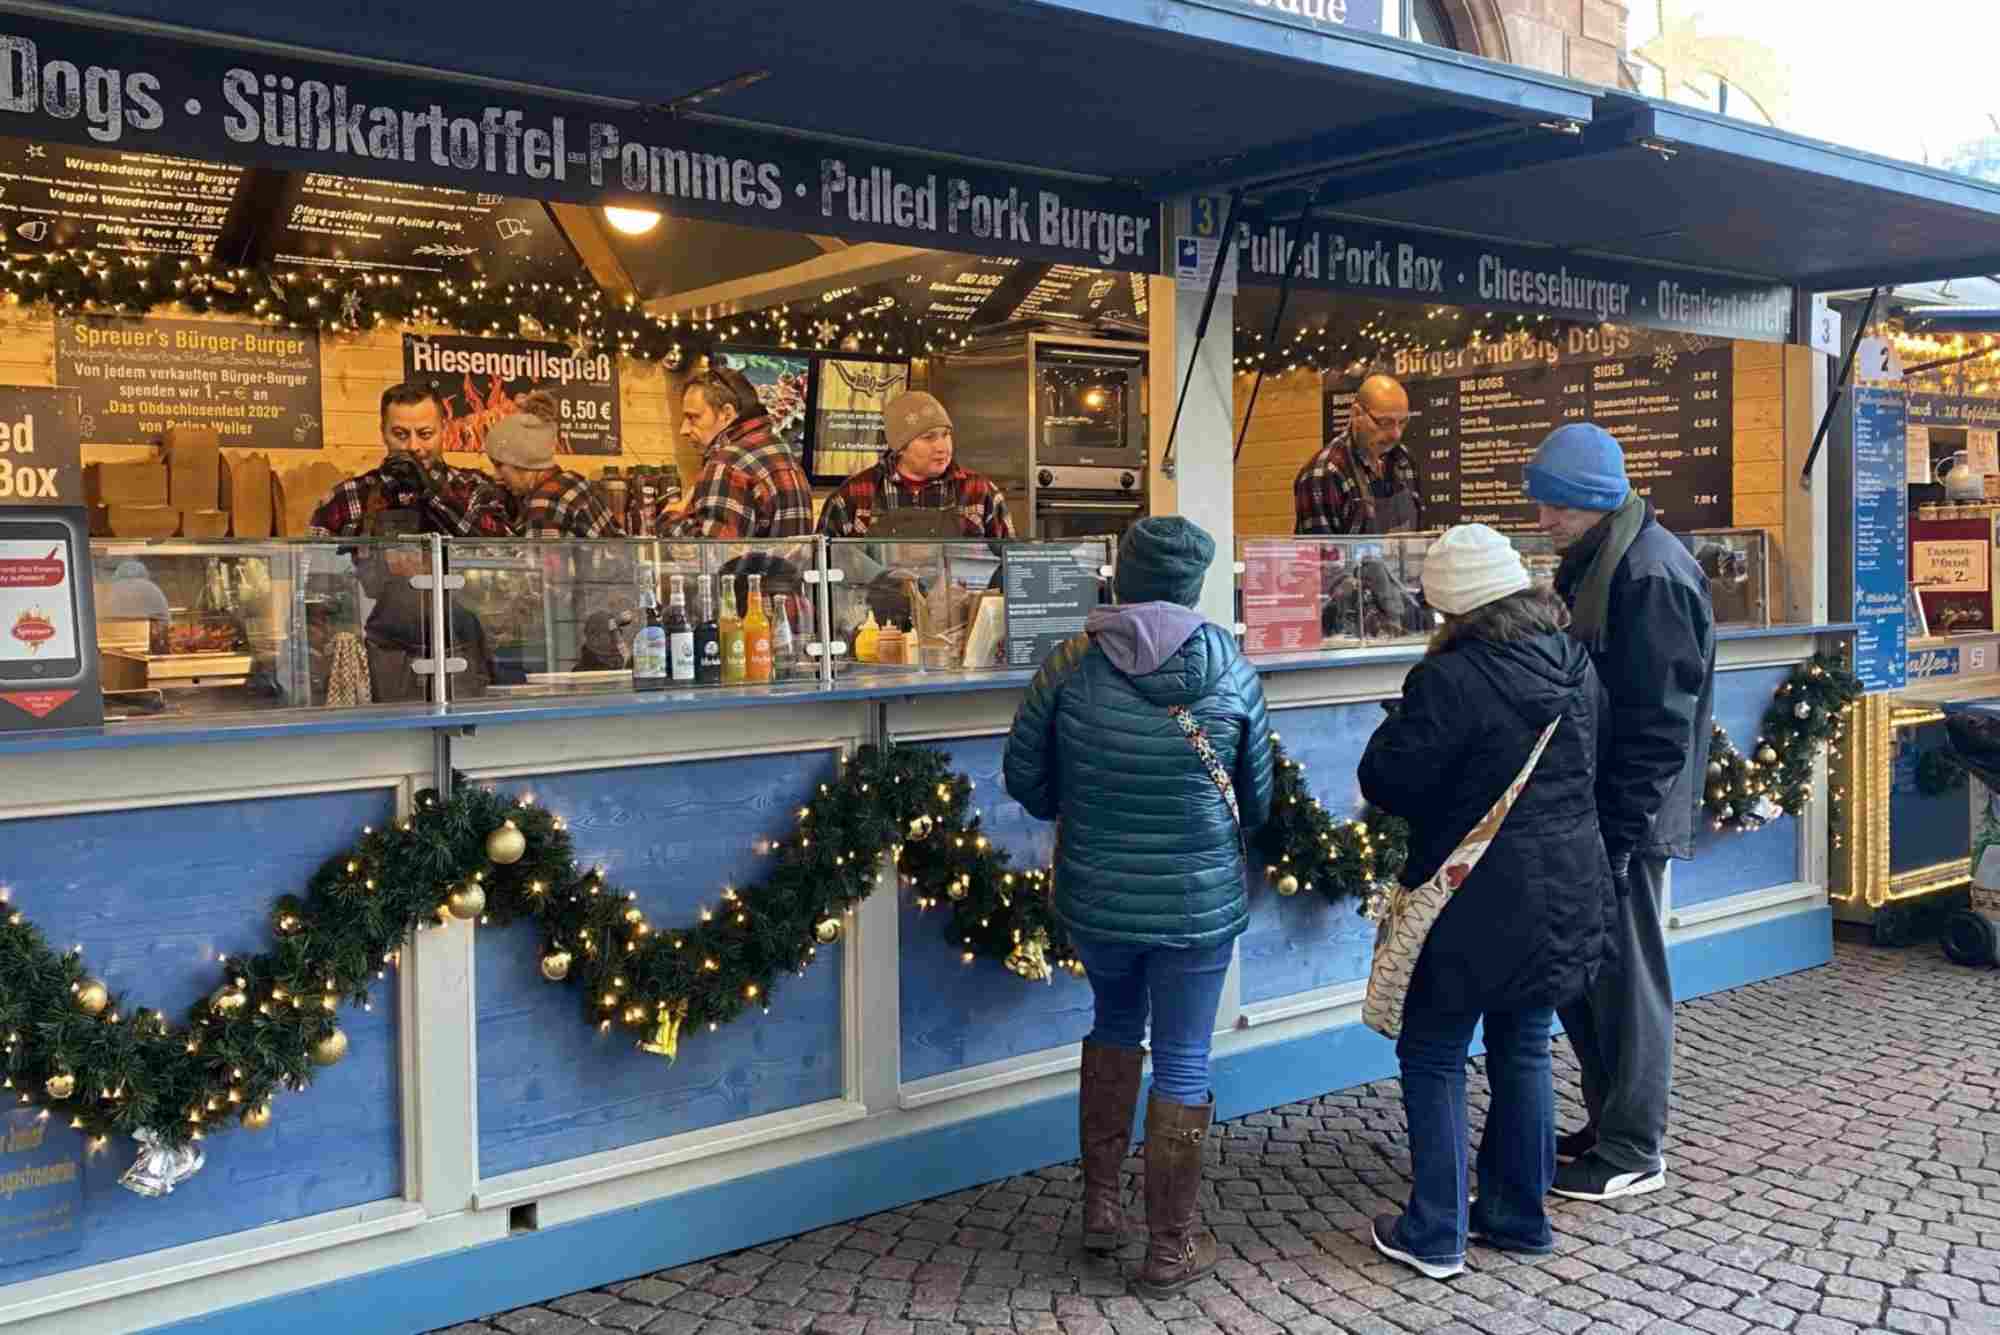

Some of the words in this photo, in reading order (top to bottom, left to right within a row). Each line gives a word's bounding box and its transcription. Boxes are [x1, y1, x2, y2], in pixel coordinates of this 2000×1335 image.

[0, 35, 164, 142] Dogs
[223, 68, 783, 209] Süßkartoffel-Pommes
[820, 159, 937, 231] Pulled
[948, 178, 1031, 242] Pork
[1039, 190, 1151, 264] Burger
[65, 157, 158, 179] Wiesbadener
[161, 168, 193, 181] Wild
[195, 170, 241, 186] Burger
[49, 187, 98, 204] Veggie
[185, 201, 230, 216] Burger
[1198, 199, 1214, 235] 3
[96, 223, 140, 237] Pulled
[143, 226, 174, 239] Pork
[1328, 233, 1391, 287] Pork
[1398, 243, 1443, 292] Box
[1478, 253, 1630, 321] Cheeseburger
[74, 324, 170, 348] Spreuer's
[175, 328, 306, 358] Bürger-Burger
[1569, 326, 1632, 357] Dogs
[1822, 318, 1830, 344] 3
[413, 341, 611, 386] Riesengrillspieß
[1594, 363, 1625, 378] SIDES
[1880, 346, 1889, 372] 2
[73, 362, 102, 378] Von
[104, 364, 147, 380] jedem
[150, 365, 217, 382] verkauften
[221, 369, 308, 386] Bürger-Burger
[119, 383, 176, 399] spenden
[178, 384, 199, 399] wir
[253, 389, 268, 400] an
[139, 400, 245, 418] Obdachlosenfest
[560, 398, 597, 421] 6,50
[600, 401, 612, 421] €
[138, 421, 162, 433] von
